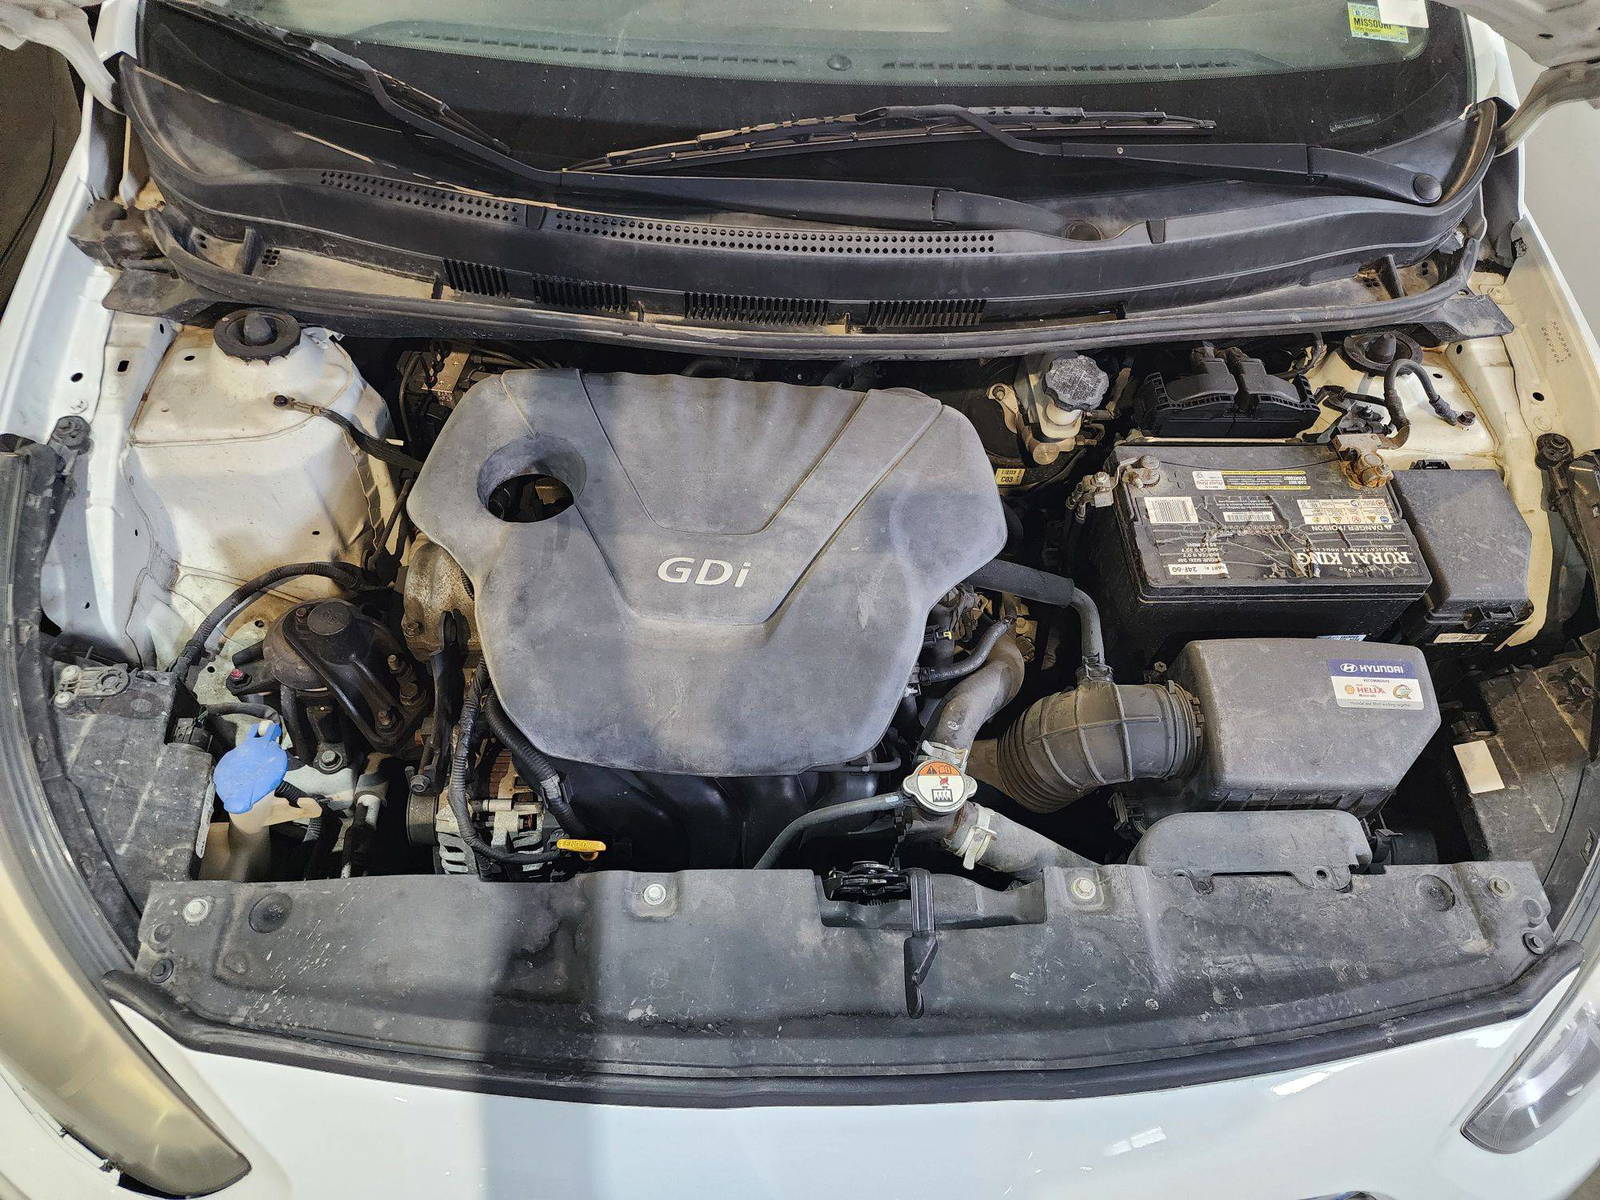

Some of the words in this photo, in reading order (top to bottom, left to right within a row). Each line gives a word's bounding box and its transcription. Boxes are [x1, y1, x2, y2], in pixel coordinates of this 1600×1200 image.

[1347, 524, 1384, 532] DANGER
[1296, 551, 1342, 566] KING
[1343, 551, 1412, 566] RURAL
[657, 557, 752, 588] GDi
[1359, 664, 1404, 674] HYUNDAI
[1356, 686, 1386, 694] HELIX
